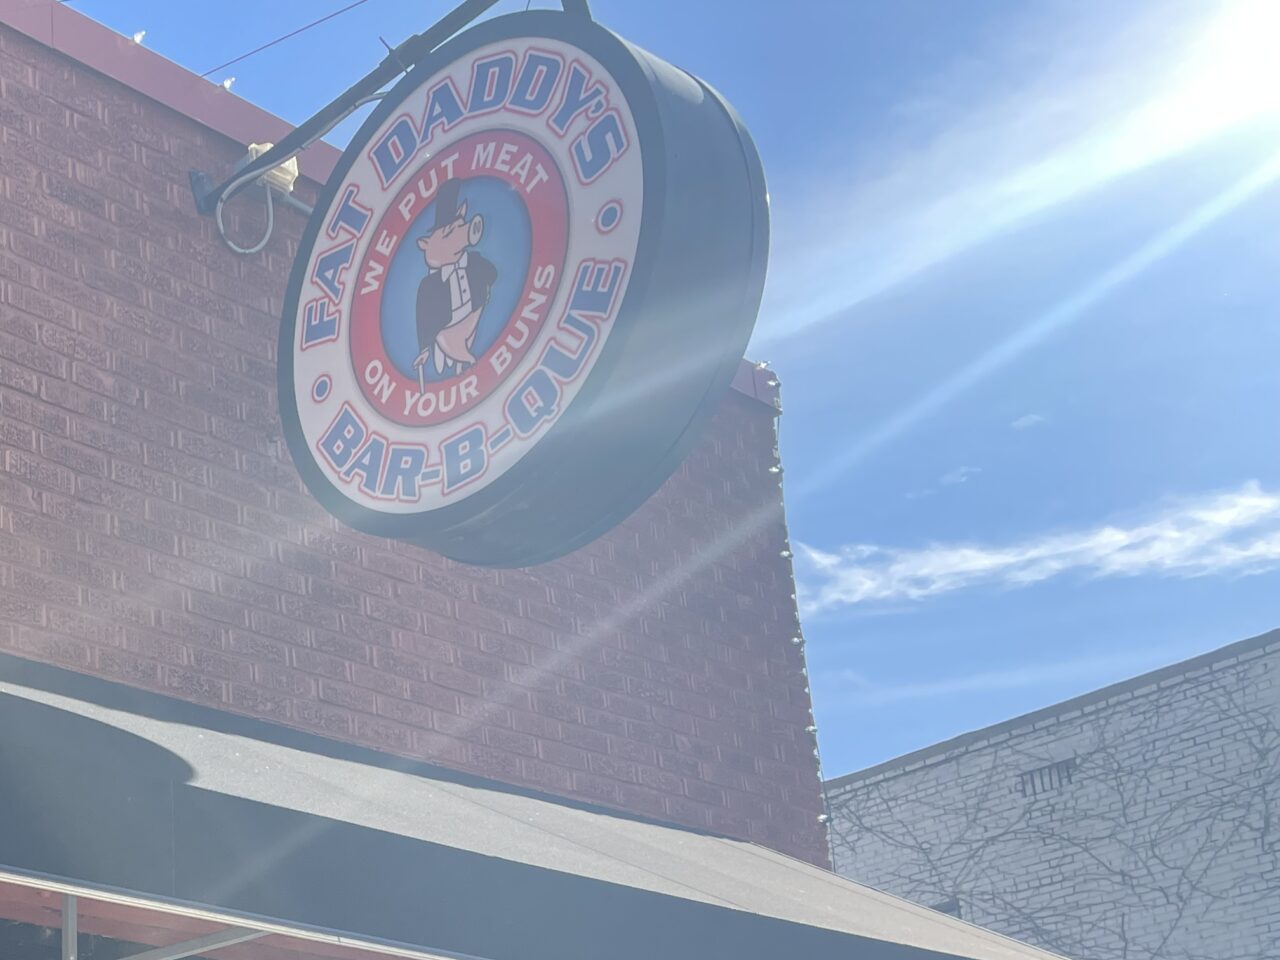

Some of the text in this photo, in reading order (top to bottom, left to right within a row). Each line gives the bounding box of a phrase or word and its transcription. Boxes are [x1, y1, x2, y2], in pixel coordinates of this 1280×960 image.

[302, 47, 628, 350] FAT DADDY'S
[360, 141, 549, 296] WE PUT MEAT
[317, 258, 627, 504] BAR-B-QUE
[364, 264, 556, 417] ON YOUR BUNS
